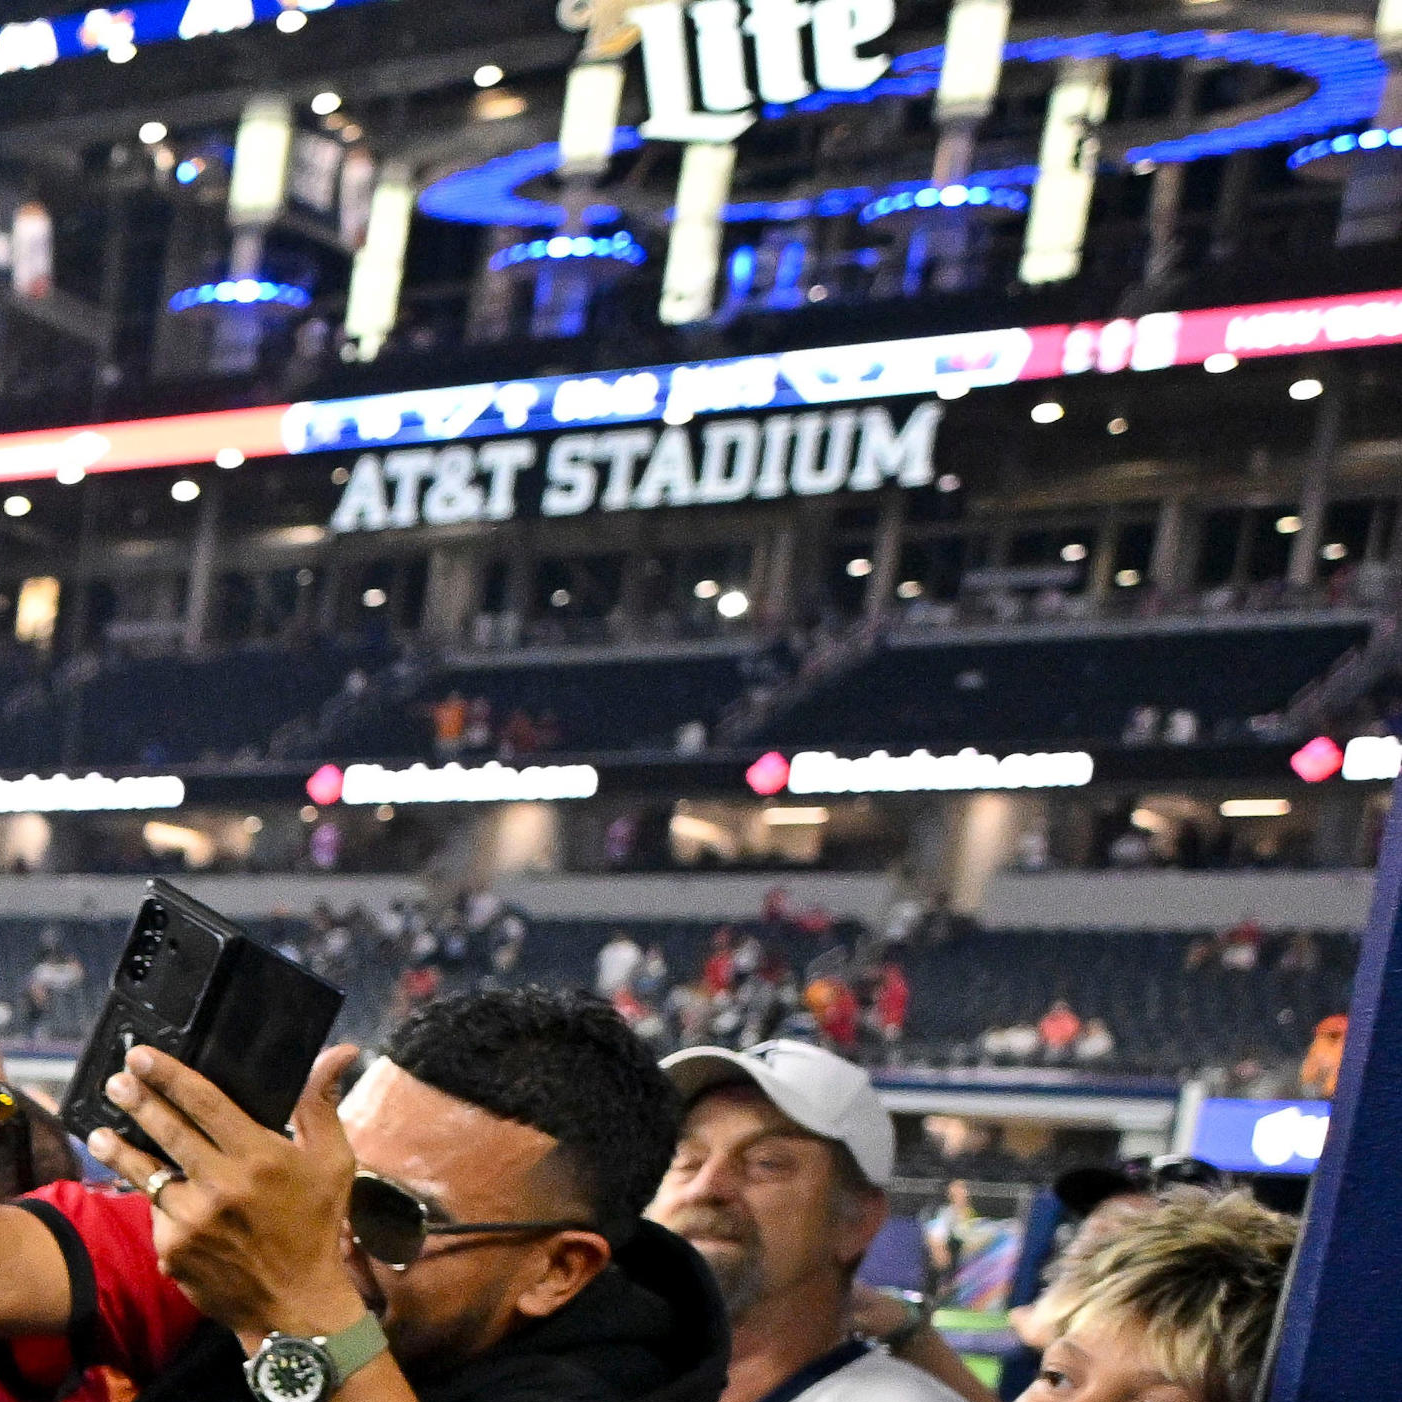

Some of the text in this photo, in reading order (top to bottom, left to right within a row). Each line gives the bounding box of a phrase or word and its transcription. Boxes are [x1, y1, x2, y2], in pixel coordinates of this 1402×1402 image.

[623, 0, 897, 143] Lite
[331, 402, 944, 534] AT&T STADIUM
